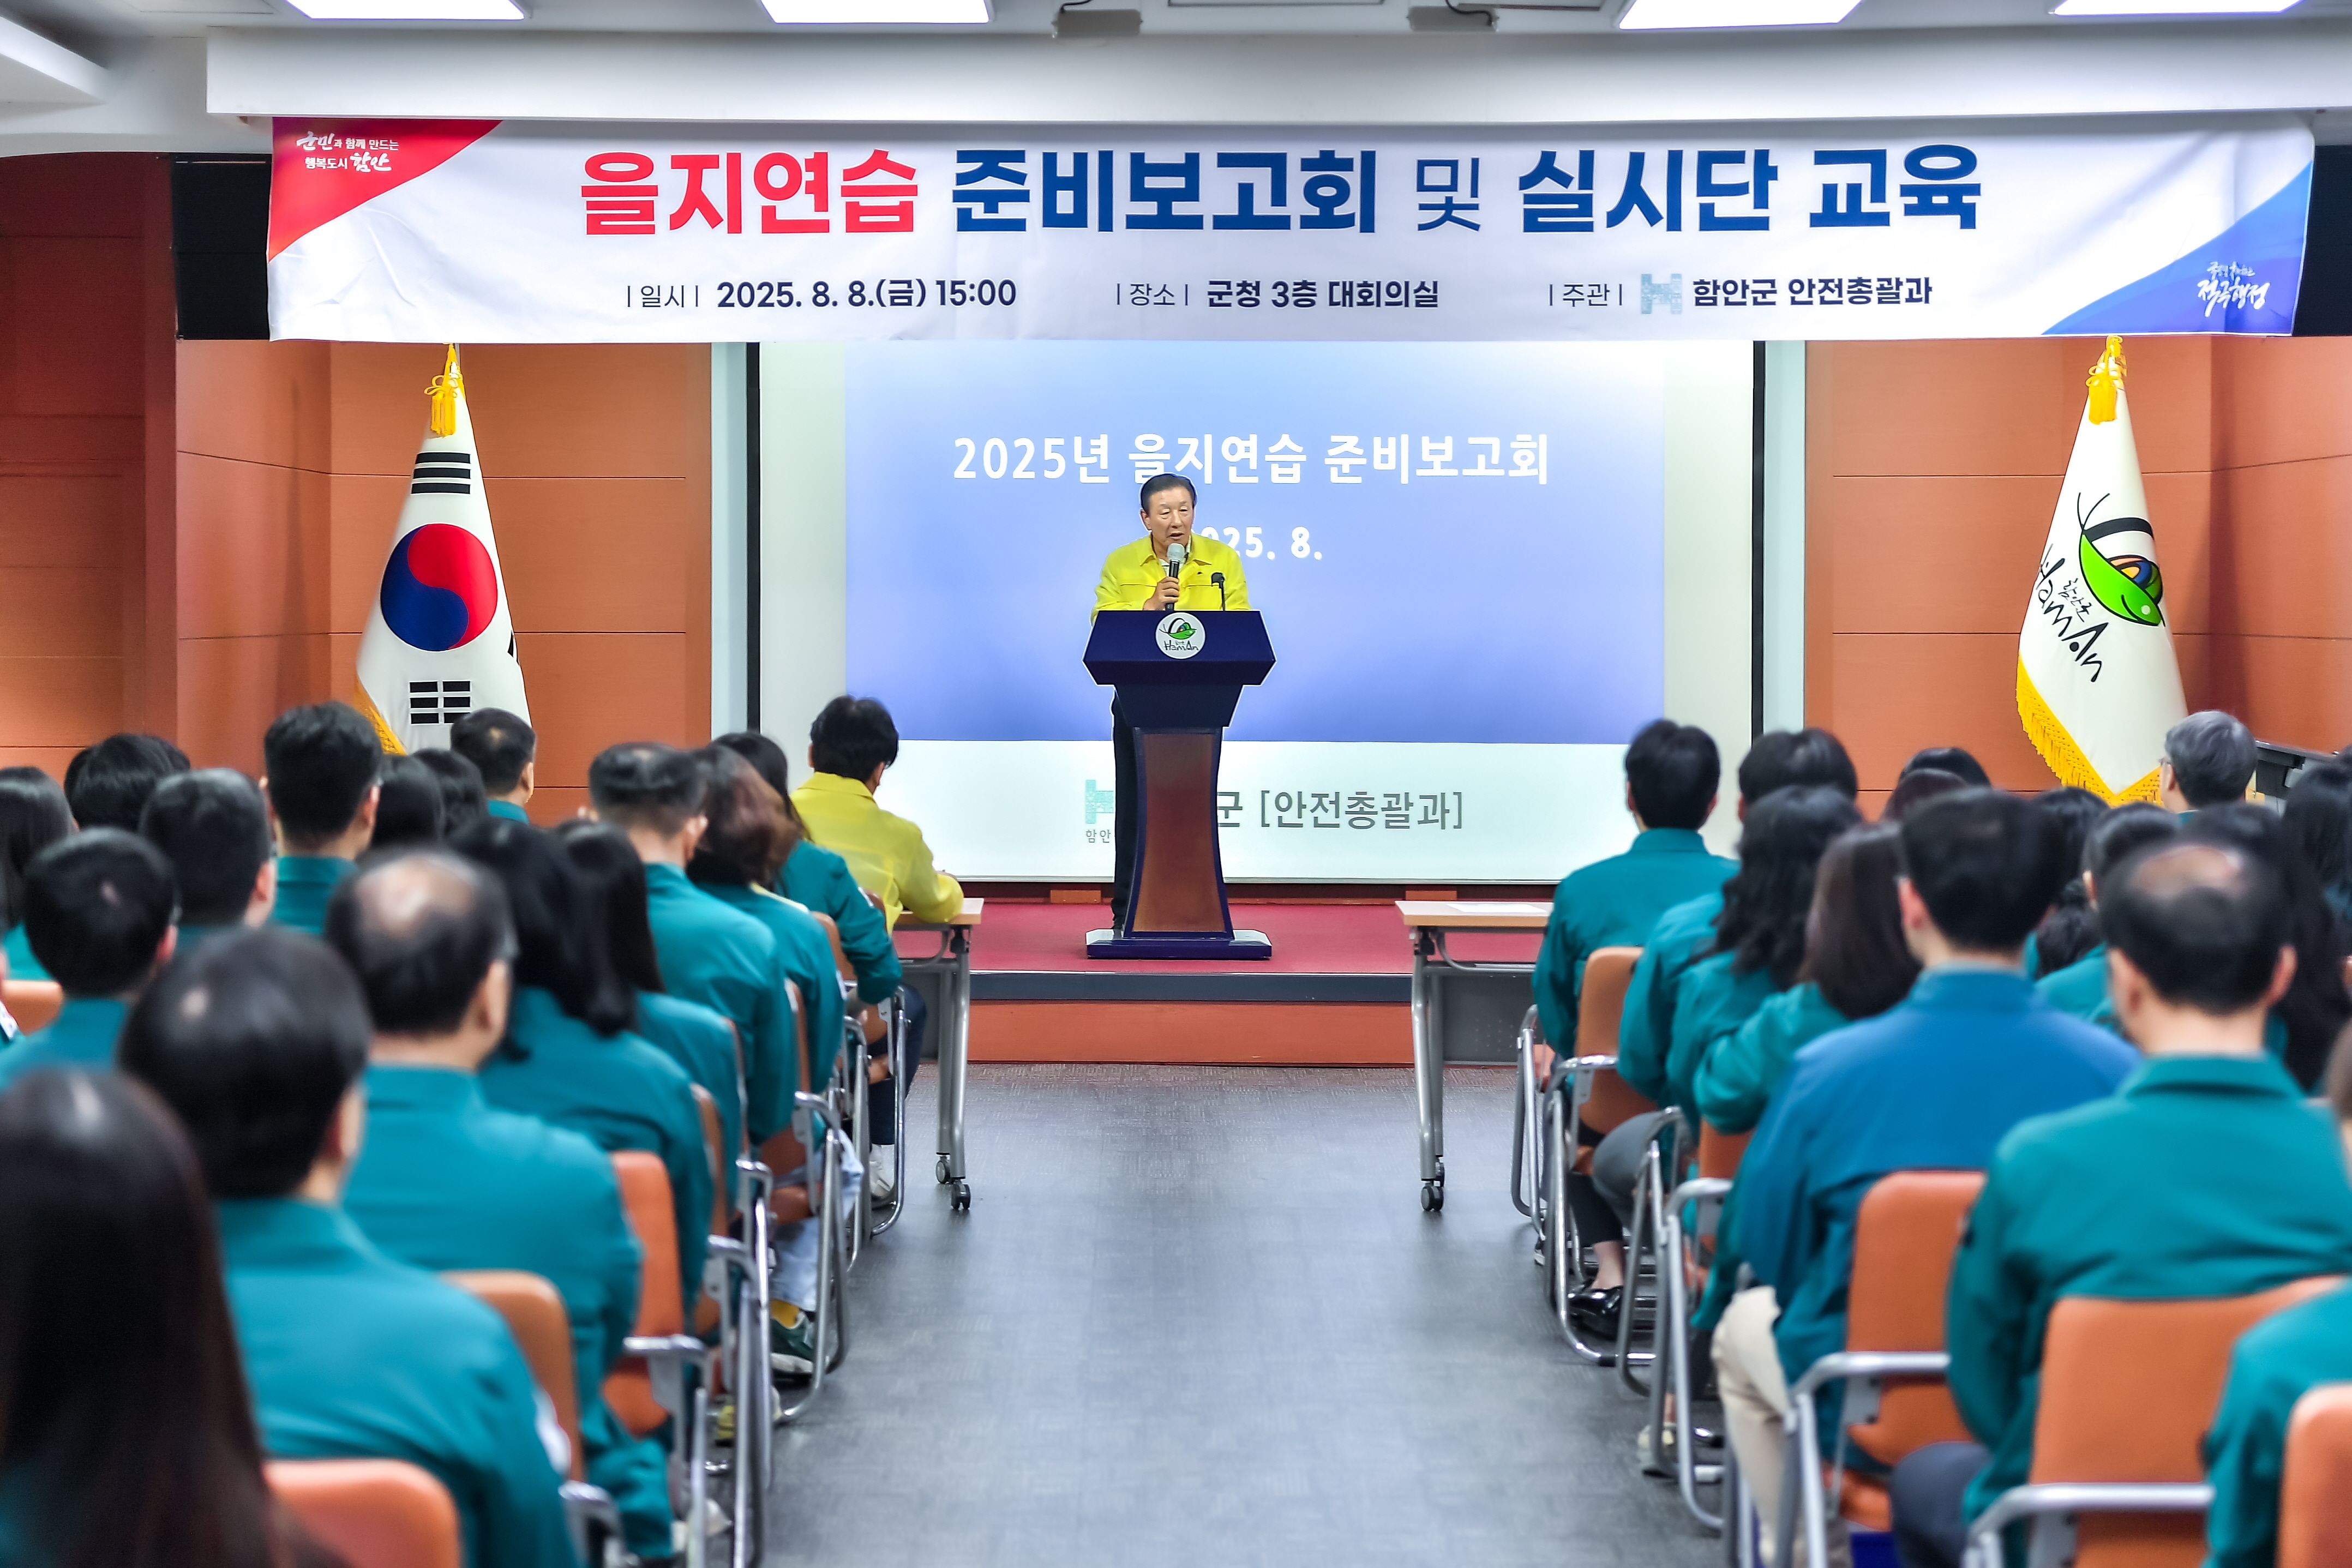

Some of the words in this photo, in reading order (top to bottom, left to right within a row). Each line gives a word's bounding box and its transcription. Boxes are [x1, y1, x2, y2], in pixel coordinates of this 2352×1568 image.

[345, 138, 366, 149] 함께
[369, 139, 399, 151] 만드는
[304, 157, 347, 170] 행복도시
[350, 151, 392, 172] 함안
[581, 149, 917, 235] 을지연습
[952, 149, 1376, 233] 준비보고회
[1417, 157, 1480, 231] 및
[1519, 149, 1778, 233] 실시단
[1809, 144, 1981, 230] 교육
[717, 281, 802, 308] 2025.
[812, 281, 838, 307] 8.
[848, 278, 926, 308] 8.(금)
[936, 279, 1016, 307] 15:00
[1207, 280, 1261, 308] 군청
[1271, 279, 1318, 308] 3층
[1329, 280, 1439, 308] 대회의실
[1693, 279, 1777, 307] 함안군
[1789, 277, 1933, 305] 안전총괄과
[953, 434, 1109, 483] 2025년
[1129, 434, 1307, 484] 을지연습
[1324, 434, 1548, 485] 준비보고회
[1291, 526, 1322, 560] 8.
[1163, 640, 1199, 651] HamAn
[1261, 790, 1462, 830] [안전총괄과]
[1085, 830, 1111, 843] 함안
